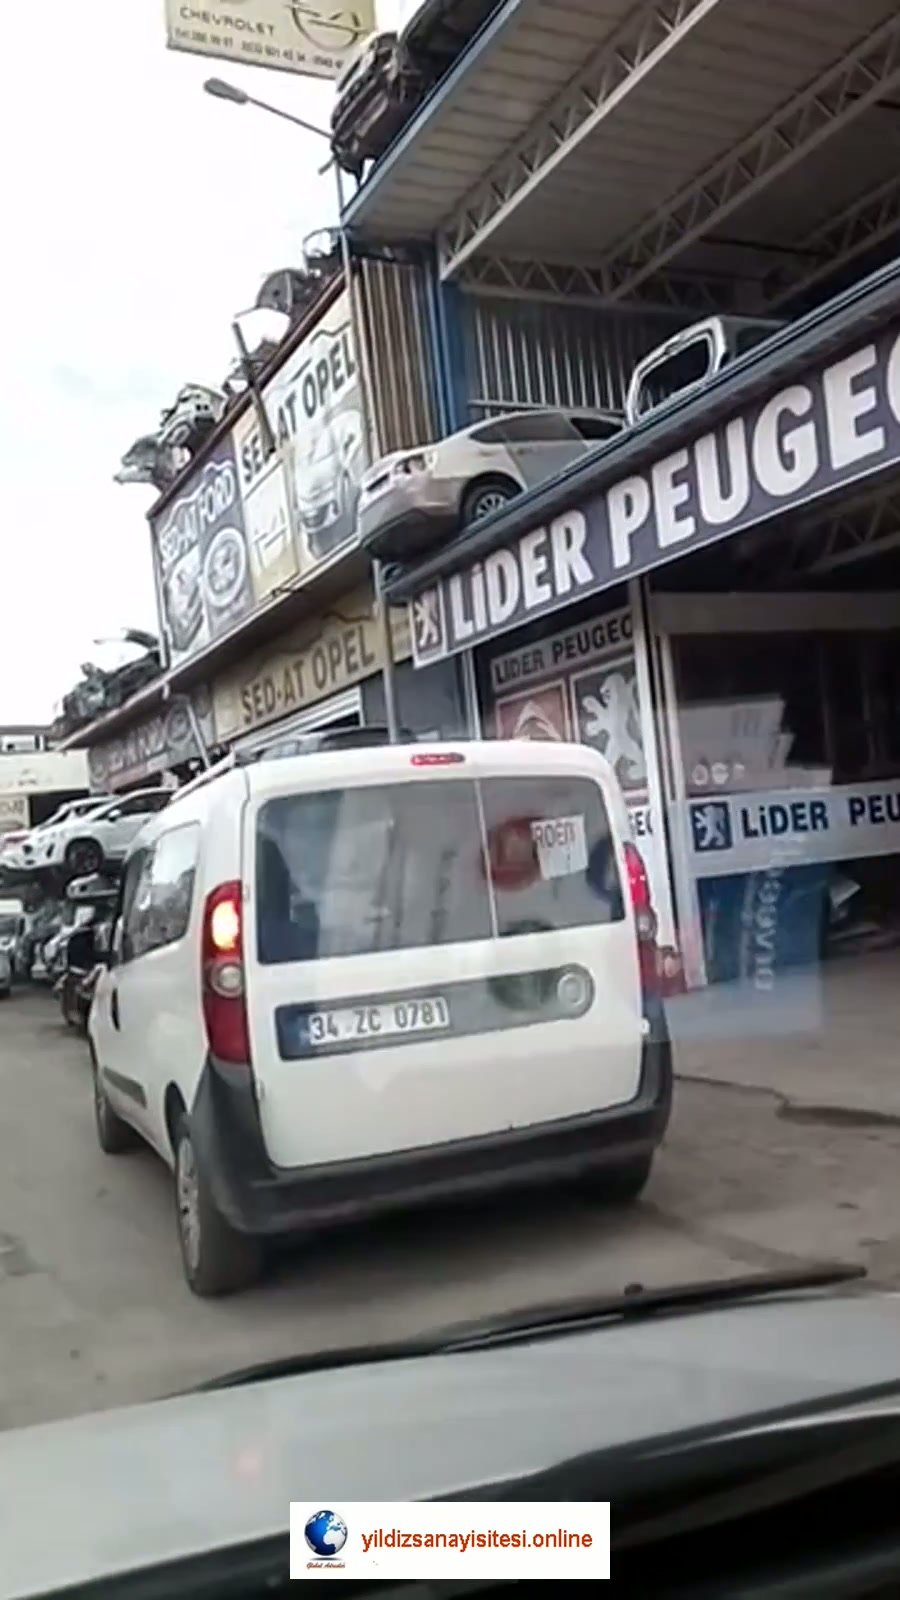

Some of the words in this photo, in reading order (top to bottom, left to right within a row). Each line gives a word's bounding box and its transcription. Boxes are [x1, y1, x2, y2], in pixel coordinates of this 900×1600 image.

[179, 6, 275, 37] CHEVROLET
[302, 333, 356, 419] OPEL
[199, 466, 235, 533] FORD
[311, 624, 375, 691] OPEL
[848, 791, 900, 827] PEU
[311, 1013, 339, 1041] 34
[354, 1007, 382, 1034] ZC
[394, 1000, 446, 1029] 0781
